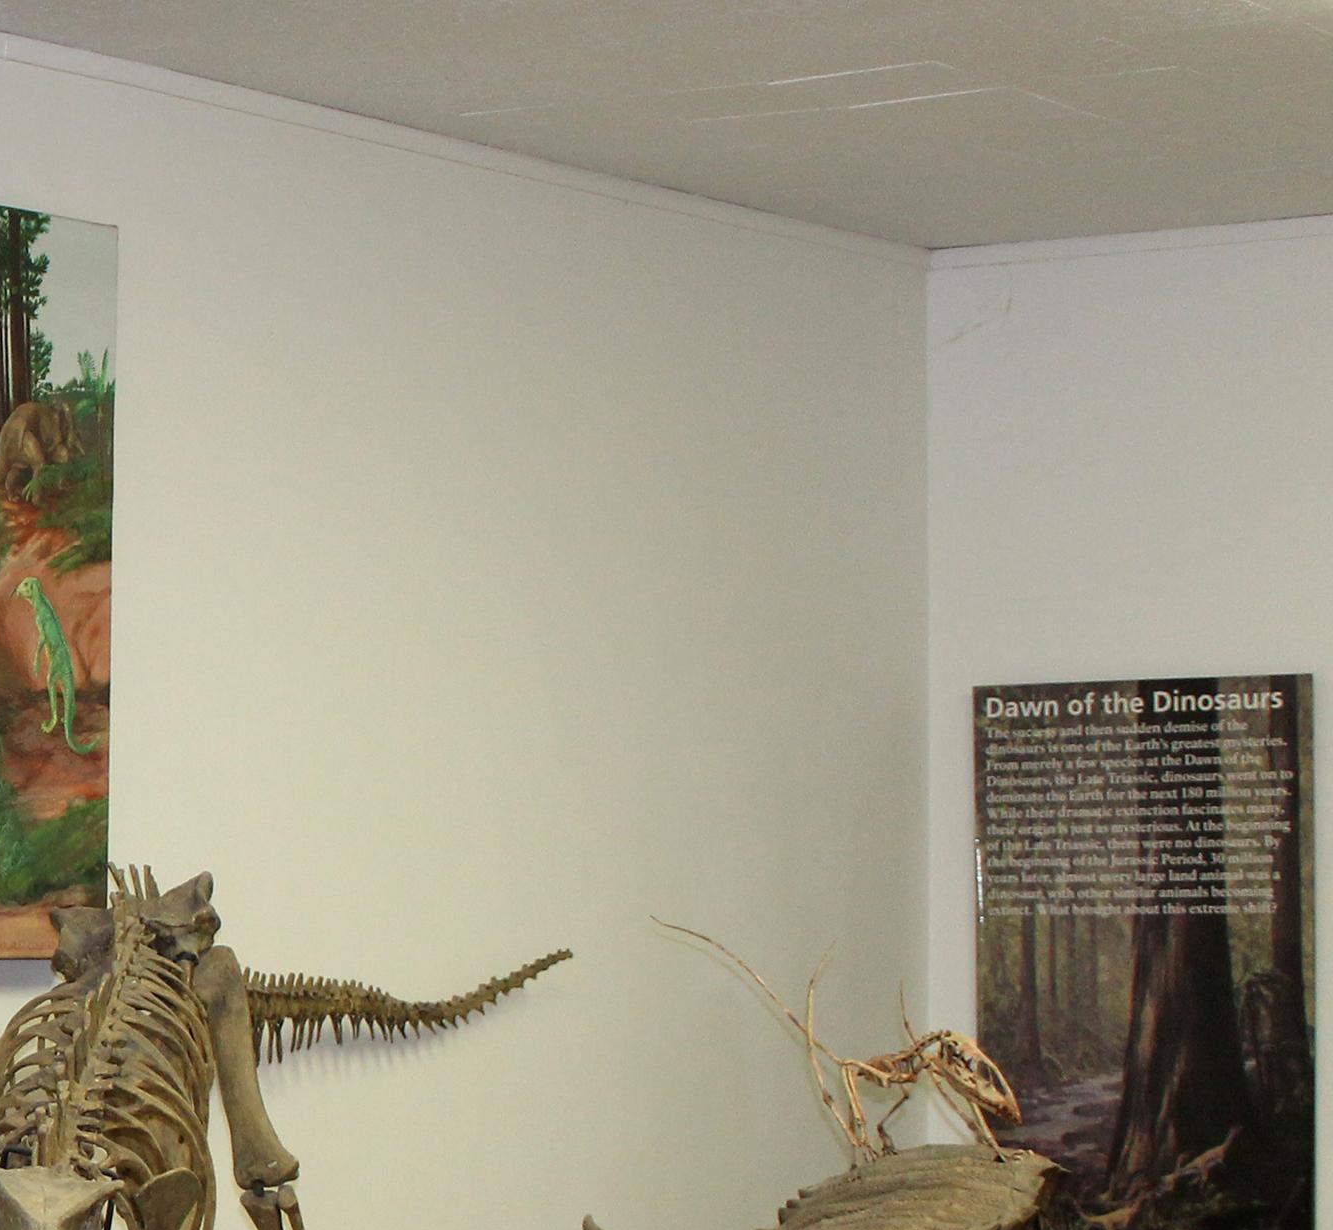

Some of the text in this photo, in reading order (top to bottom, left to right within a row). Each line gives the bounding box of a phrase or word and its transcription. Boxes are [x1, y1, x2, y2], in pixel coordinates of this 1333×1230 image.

[985, 689, 1282, 718] Dawn of the Dinosaurs
[985, 725, 1009, 739] The
[1060, 724, 1082, 736] and
[1084, 723, 1113, 736] then
[1116, 722, 1160, 734] sudden
[1163, 721, 1207, 733] demise
[1211, 720, 1225, 731] of
[1226, 719, 1248, 731] the
[985, 741, 1045, 755] dinosaurs
[1047, 741, 1059, 753] is
[1060, 742, 1083, 752] one
[1085, 739, 1100, 751] of
[1101, 739, 1122, 751] the
[1170, 738, 1220, 752] greatest
